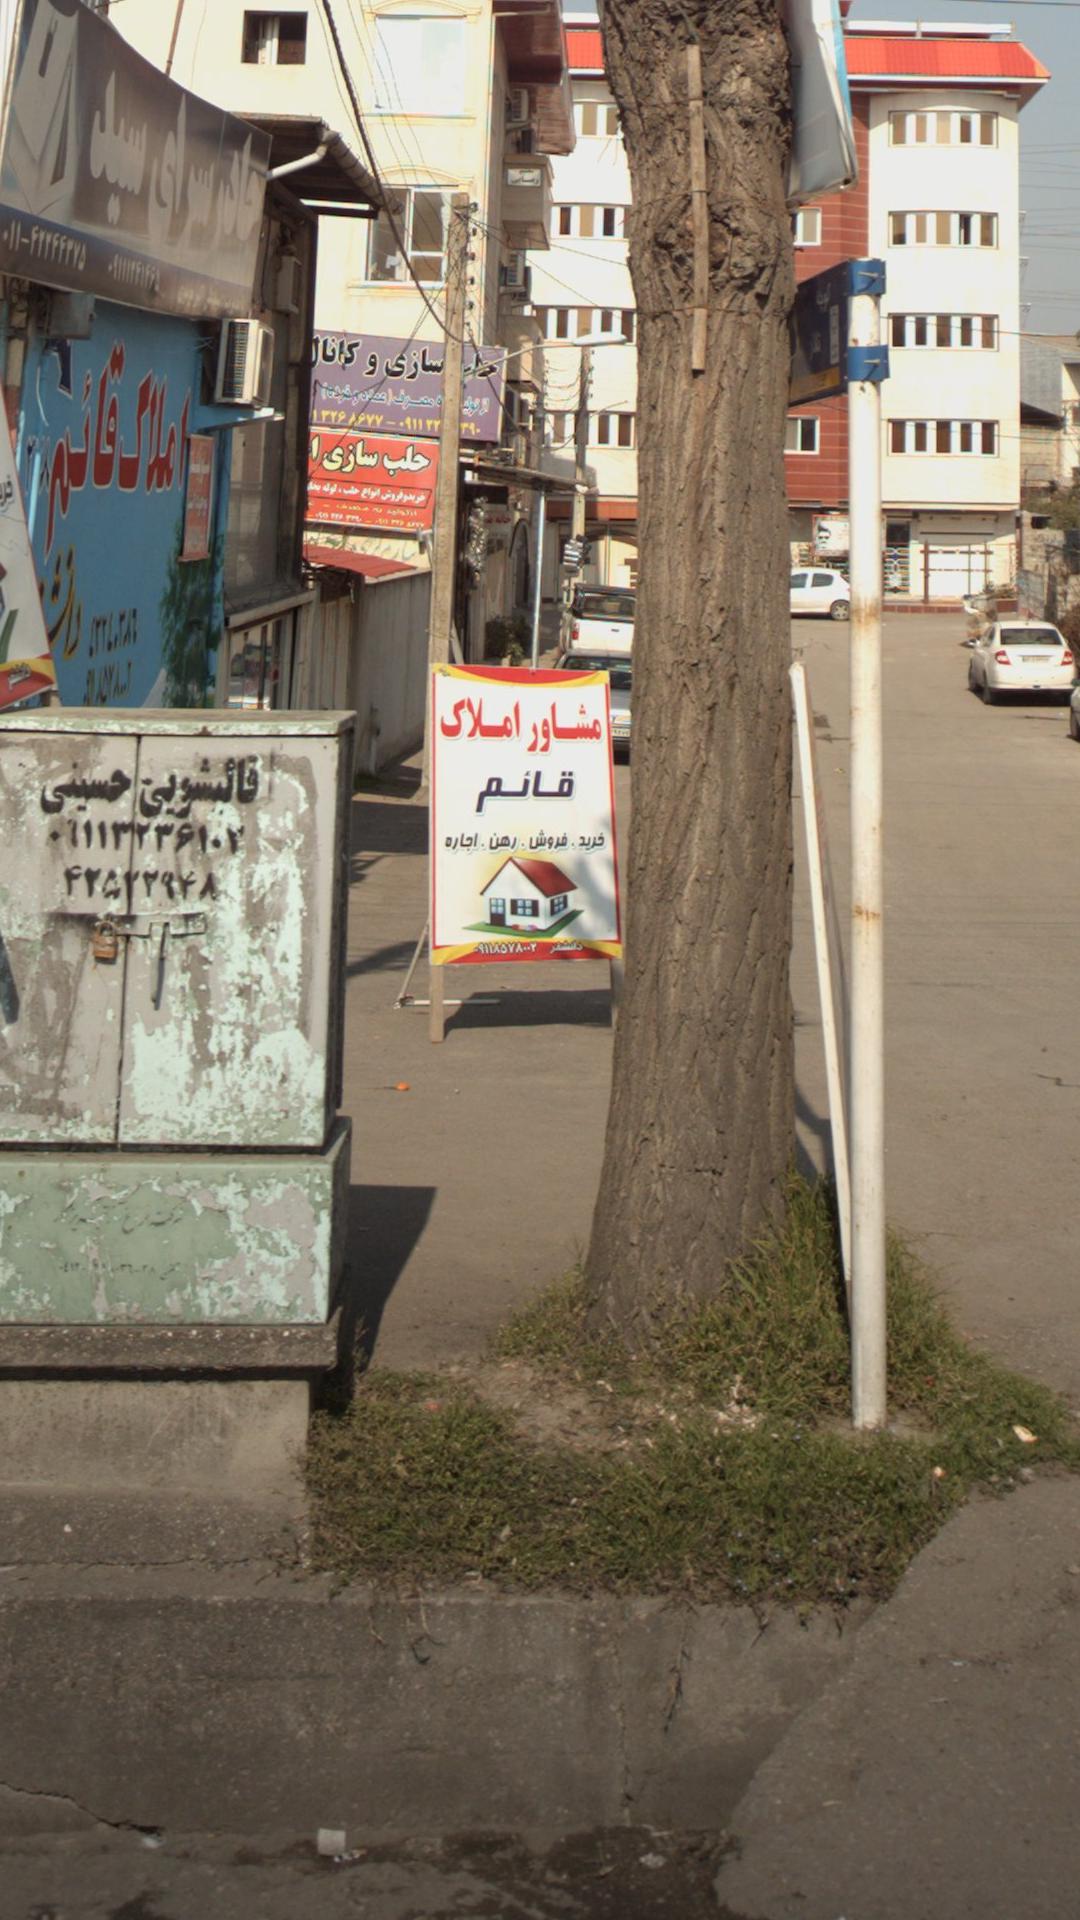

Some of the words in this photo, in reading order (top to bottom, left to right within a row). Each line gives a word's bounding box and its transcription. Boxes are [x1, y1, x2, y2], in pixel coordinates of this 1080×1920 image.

[364, 352, 378, 376] و
[118, 369, 191, 493] املاک
[460, 422, 481, 436] ۳۹۰
[45, 339, 125, 558] قائم
[322, 439, 379, 474] سازی
[382, 444, 431, 477] حلب
[441, 697, 520, 738] املاک
[527, 701, 602, 752] مشاور
[40, 762, 131, 813] حسینی
[475, 770, 575, 813] قائم
[444, 832, 478, 851] اجاره
[489, 832, 517, 850] رهن
[529, 830, 568, 850] فروش
[579, 832, 605, 850] خرید
